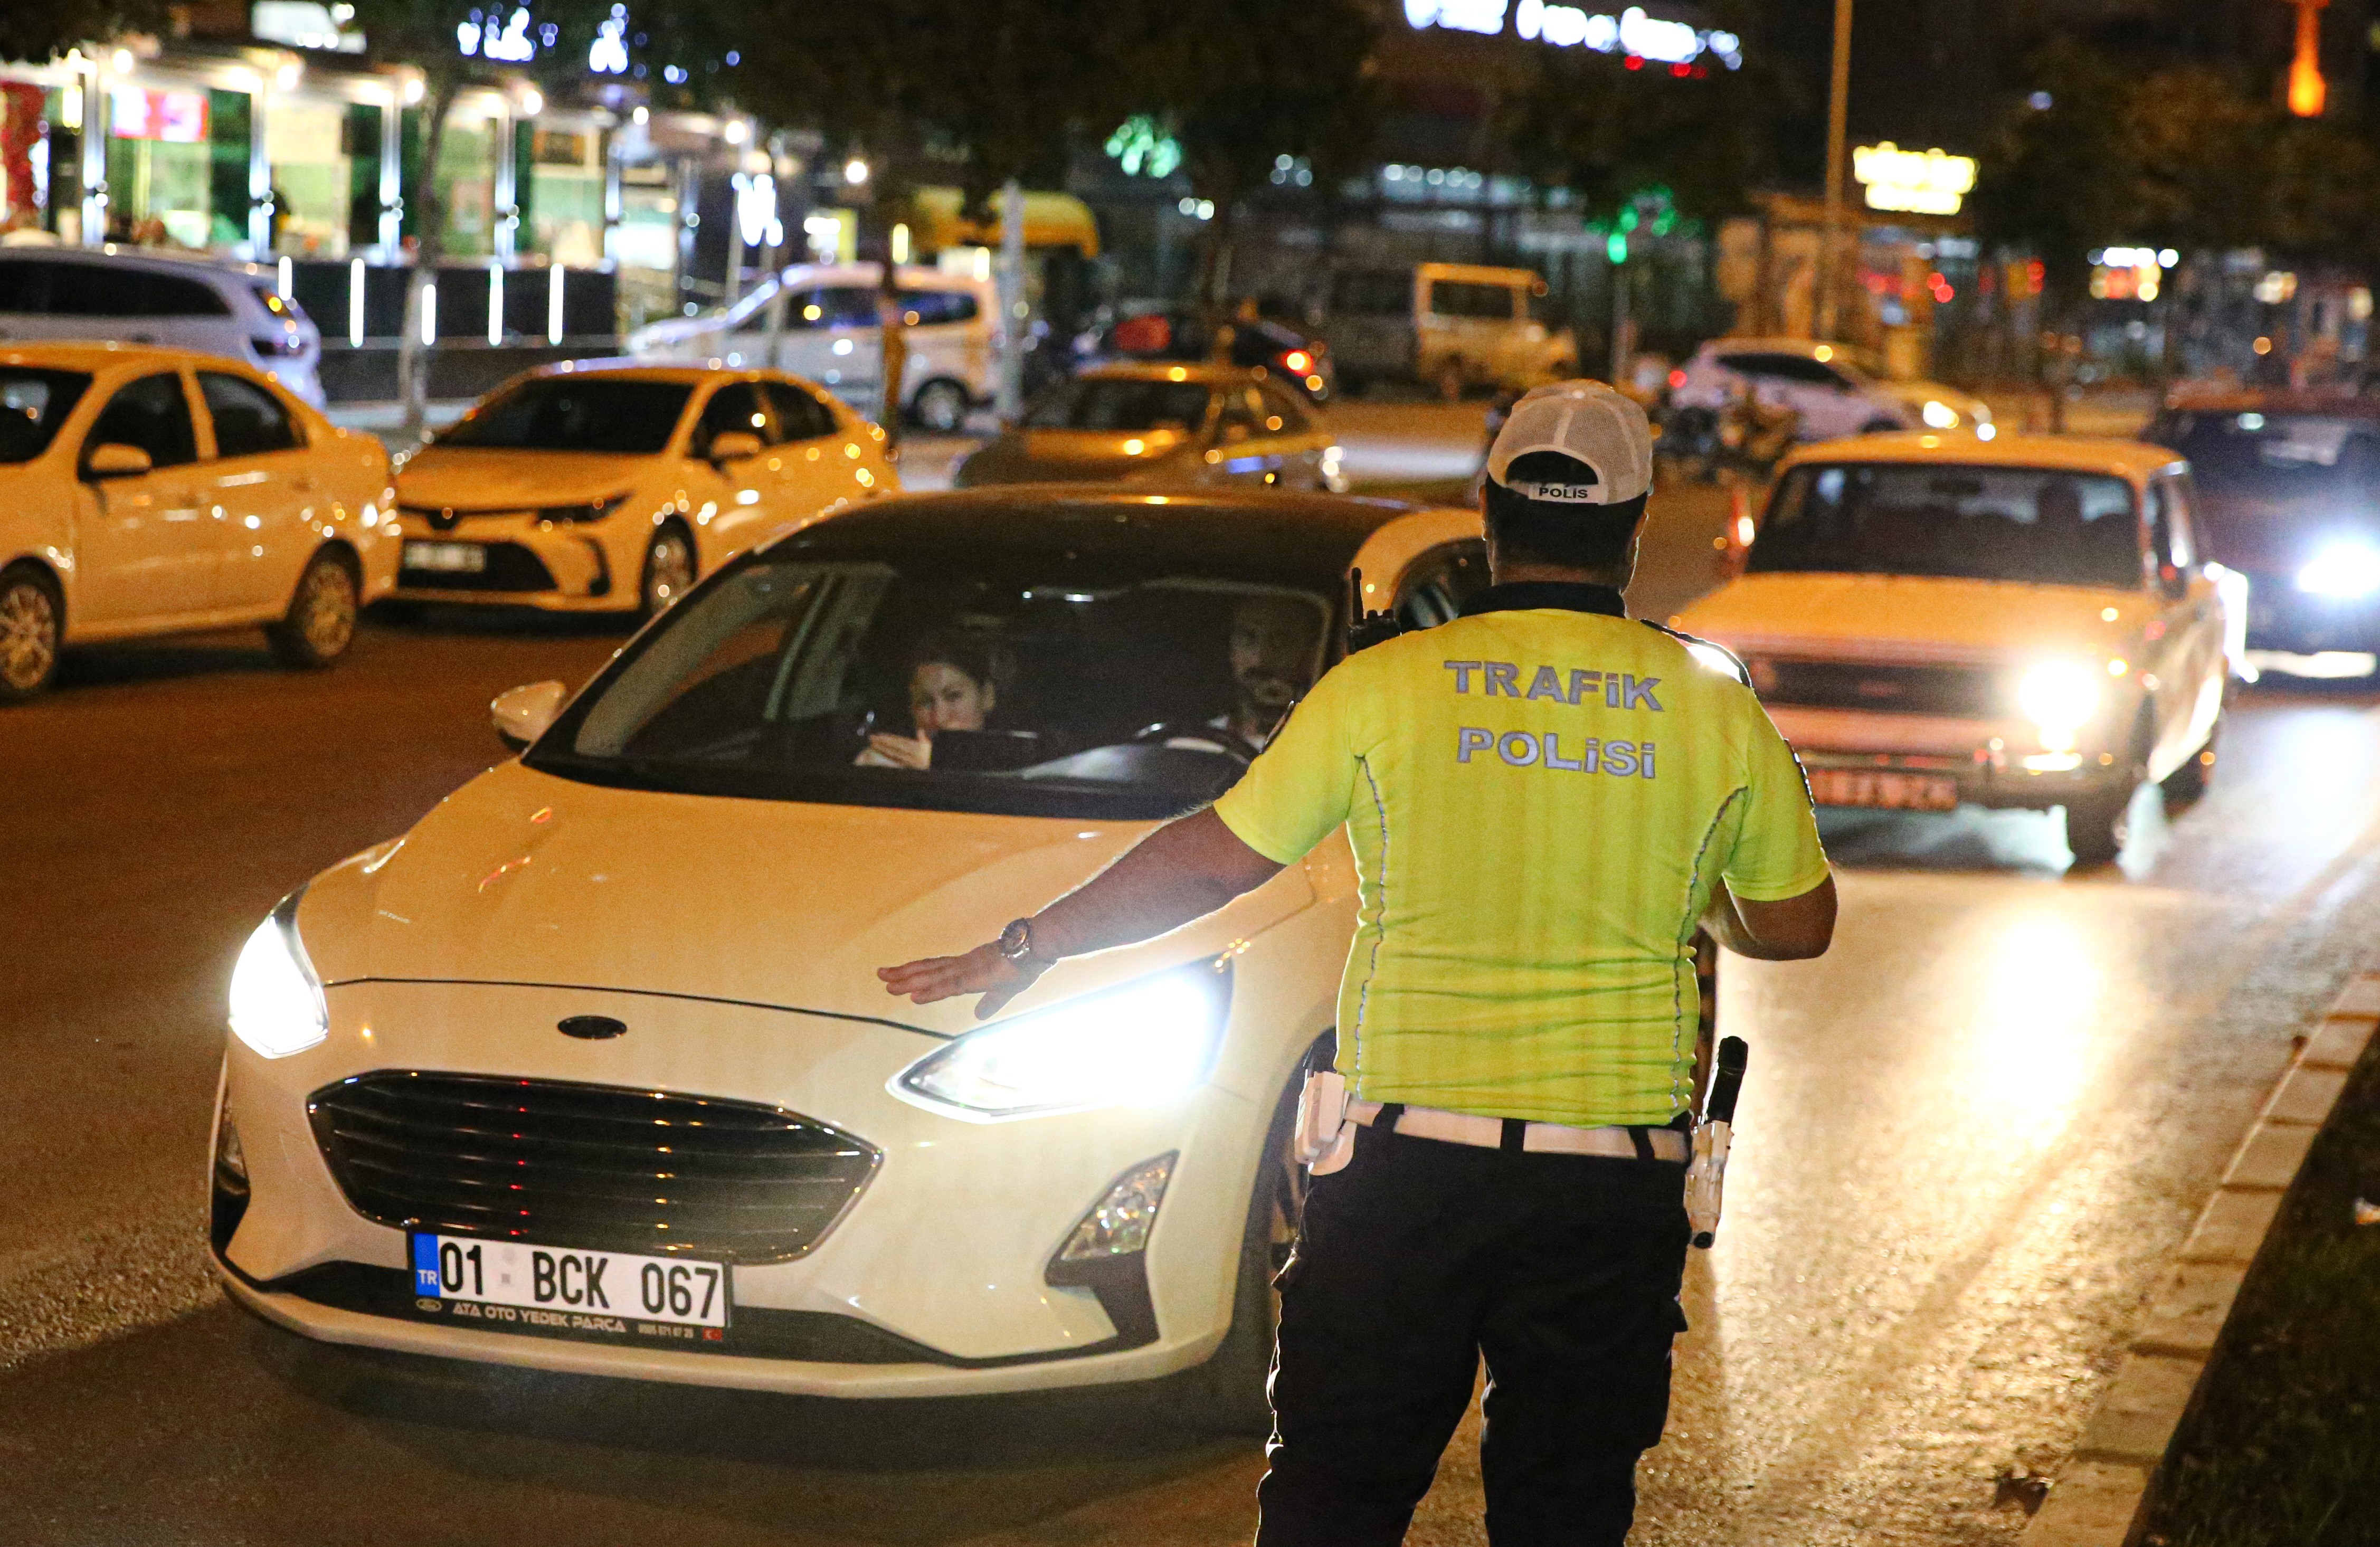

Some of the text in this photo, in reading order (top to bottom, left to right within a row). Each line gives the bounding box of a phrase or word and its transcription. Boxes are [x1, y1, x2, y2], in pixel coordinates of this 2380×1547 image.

[417, 1241, 718, 1319] TR 01 BCK 067
[453, 1302, 482, 1317] ATA
[484, 1305, 516, 1322] OTO
[520, 1309, 570, 1327] YEDEK
